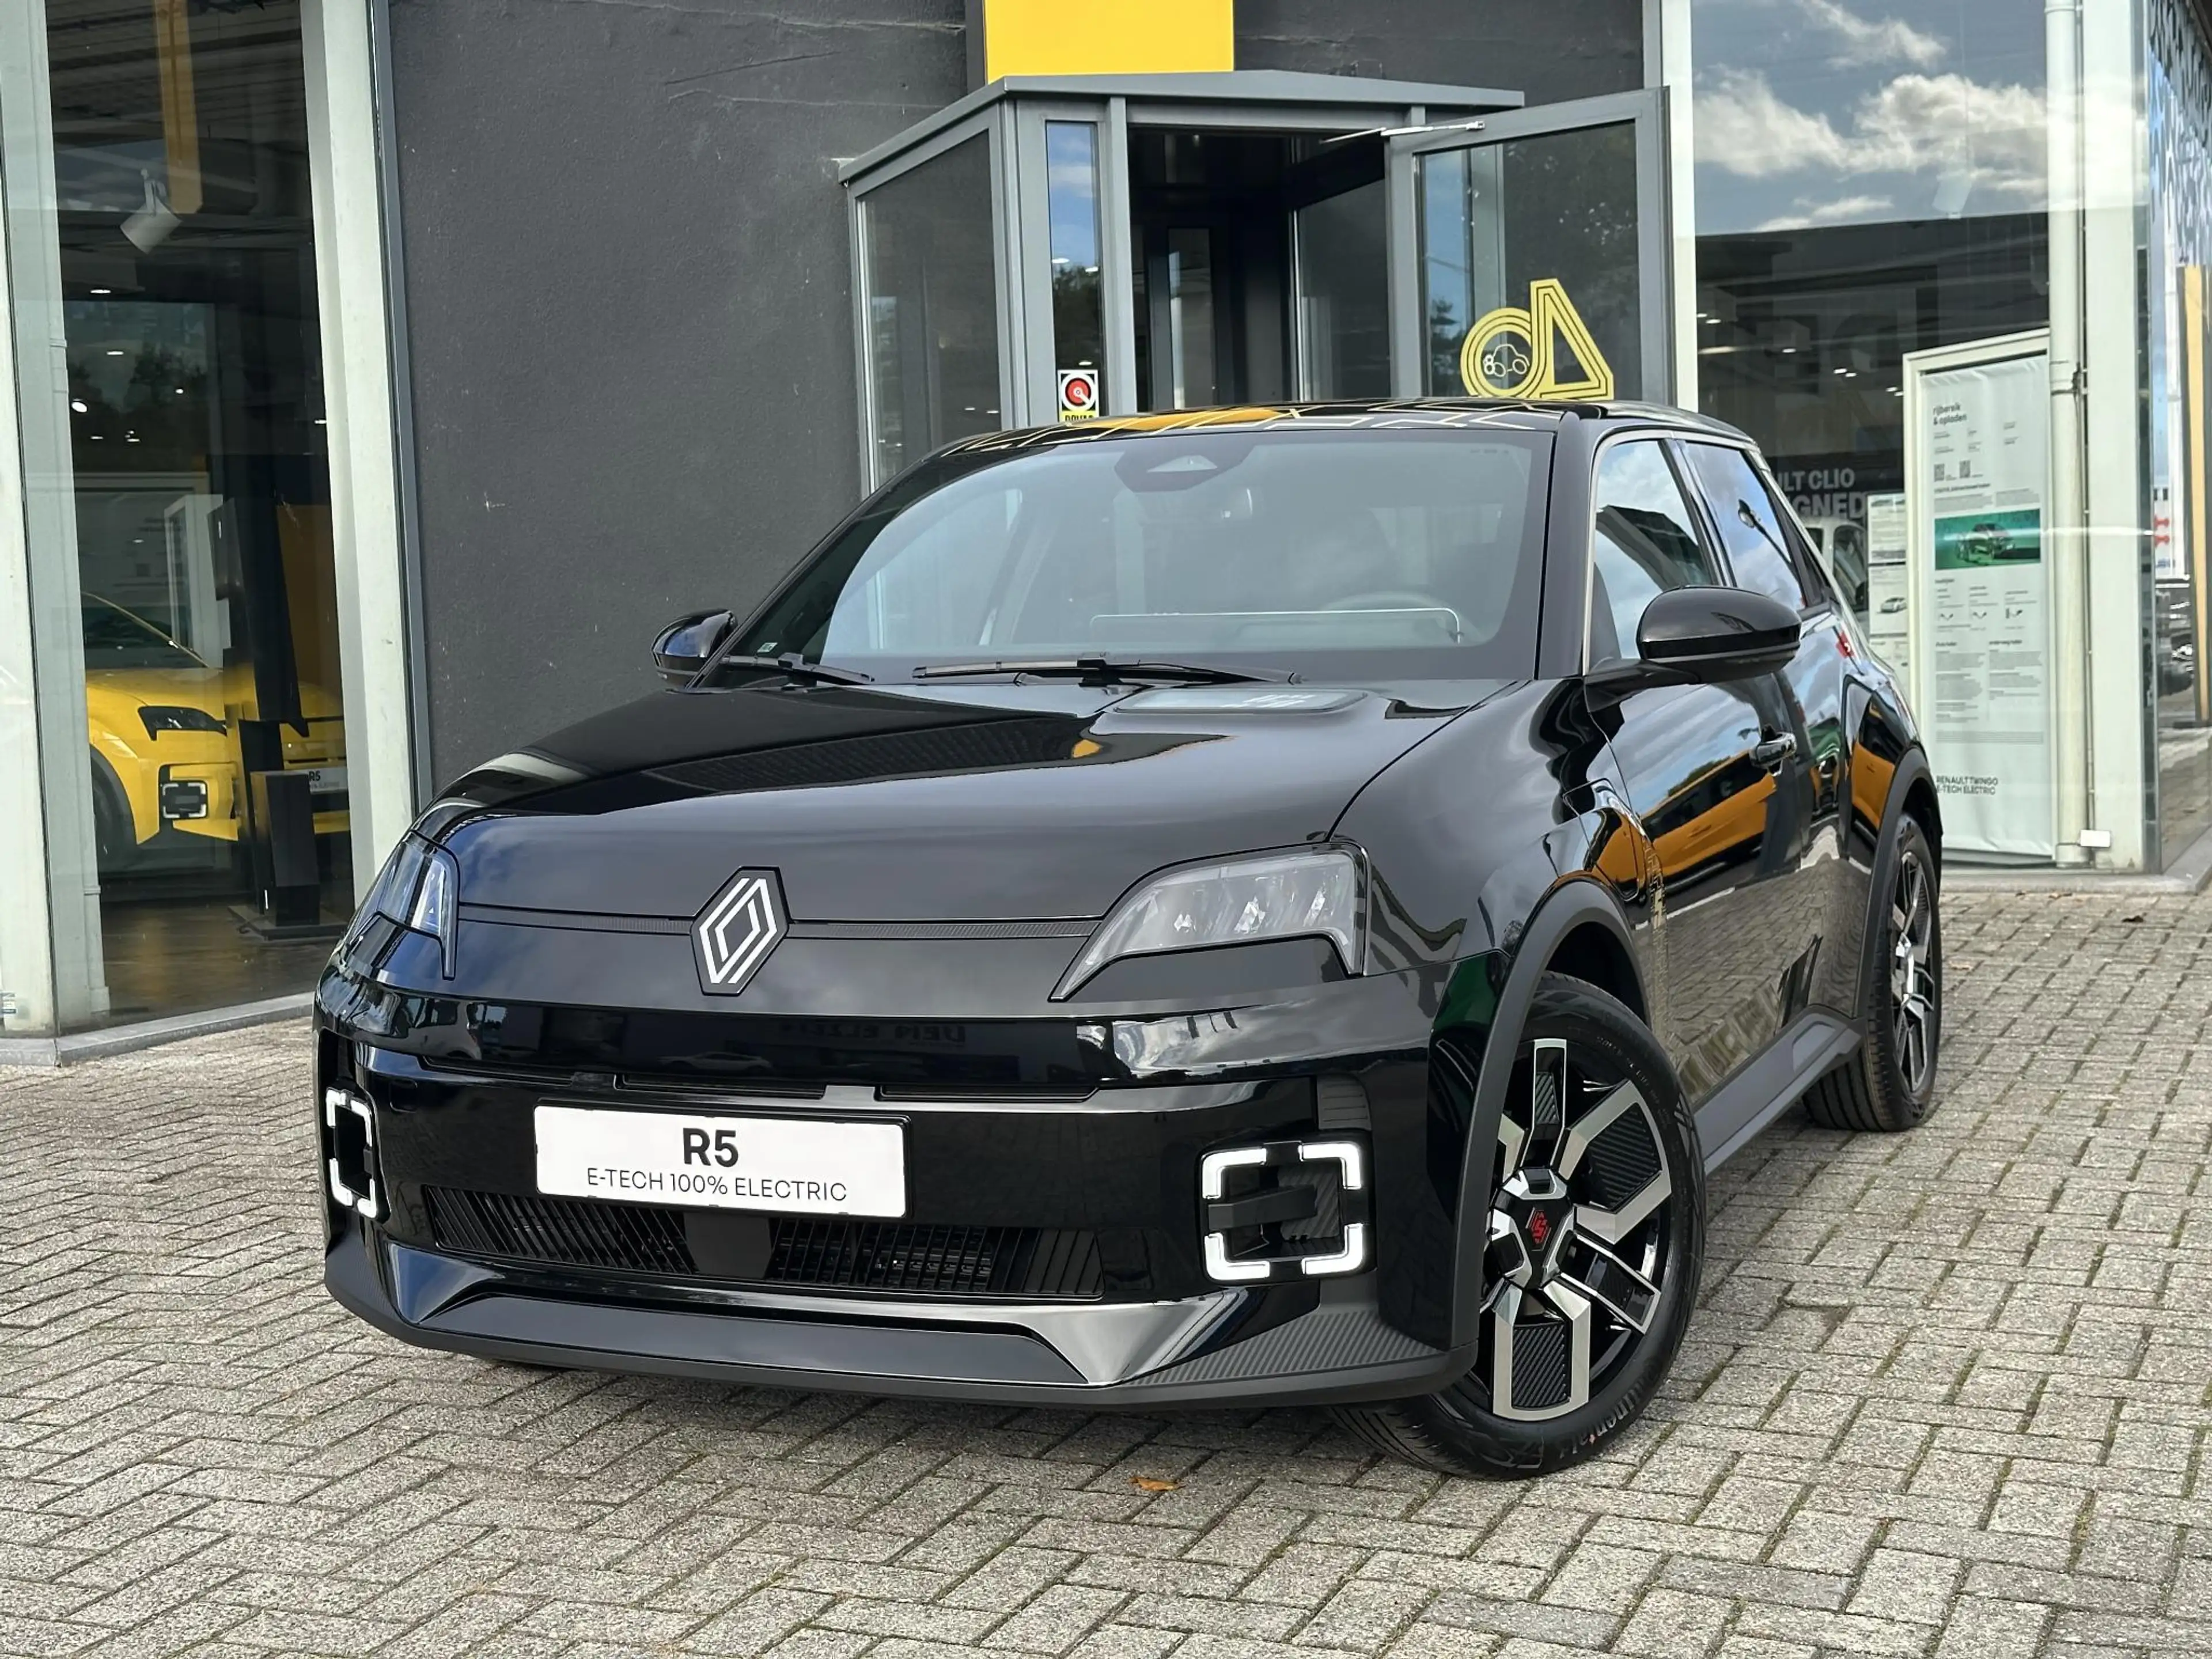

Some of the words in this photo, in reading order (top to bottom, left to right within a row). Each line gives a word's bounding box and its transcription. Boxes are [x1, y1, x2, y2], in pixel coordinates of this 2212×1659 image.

[1940, 414, 1967, 425] opladen
[1808, 468, 1855, 491] CLIO
[1787, 492, 1866, 519] GNED
[309, 770, 321, 782] R5
[1937, 776, 1969, 785] RENAULT
[1969, 777, 1998, 786] TWINGO
[1964, 785, 1995, 795] ELECTRIC
[682, 1127, 739, 1167] R5
[587, 1167, 664, 1191] E-TECH
[670, 1173, 728, 1195] 100%
[735, 1177, 847, 1202] ELECTRIC
